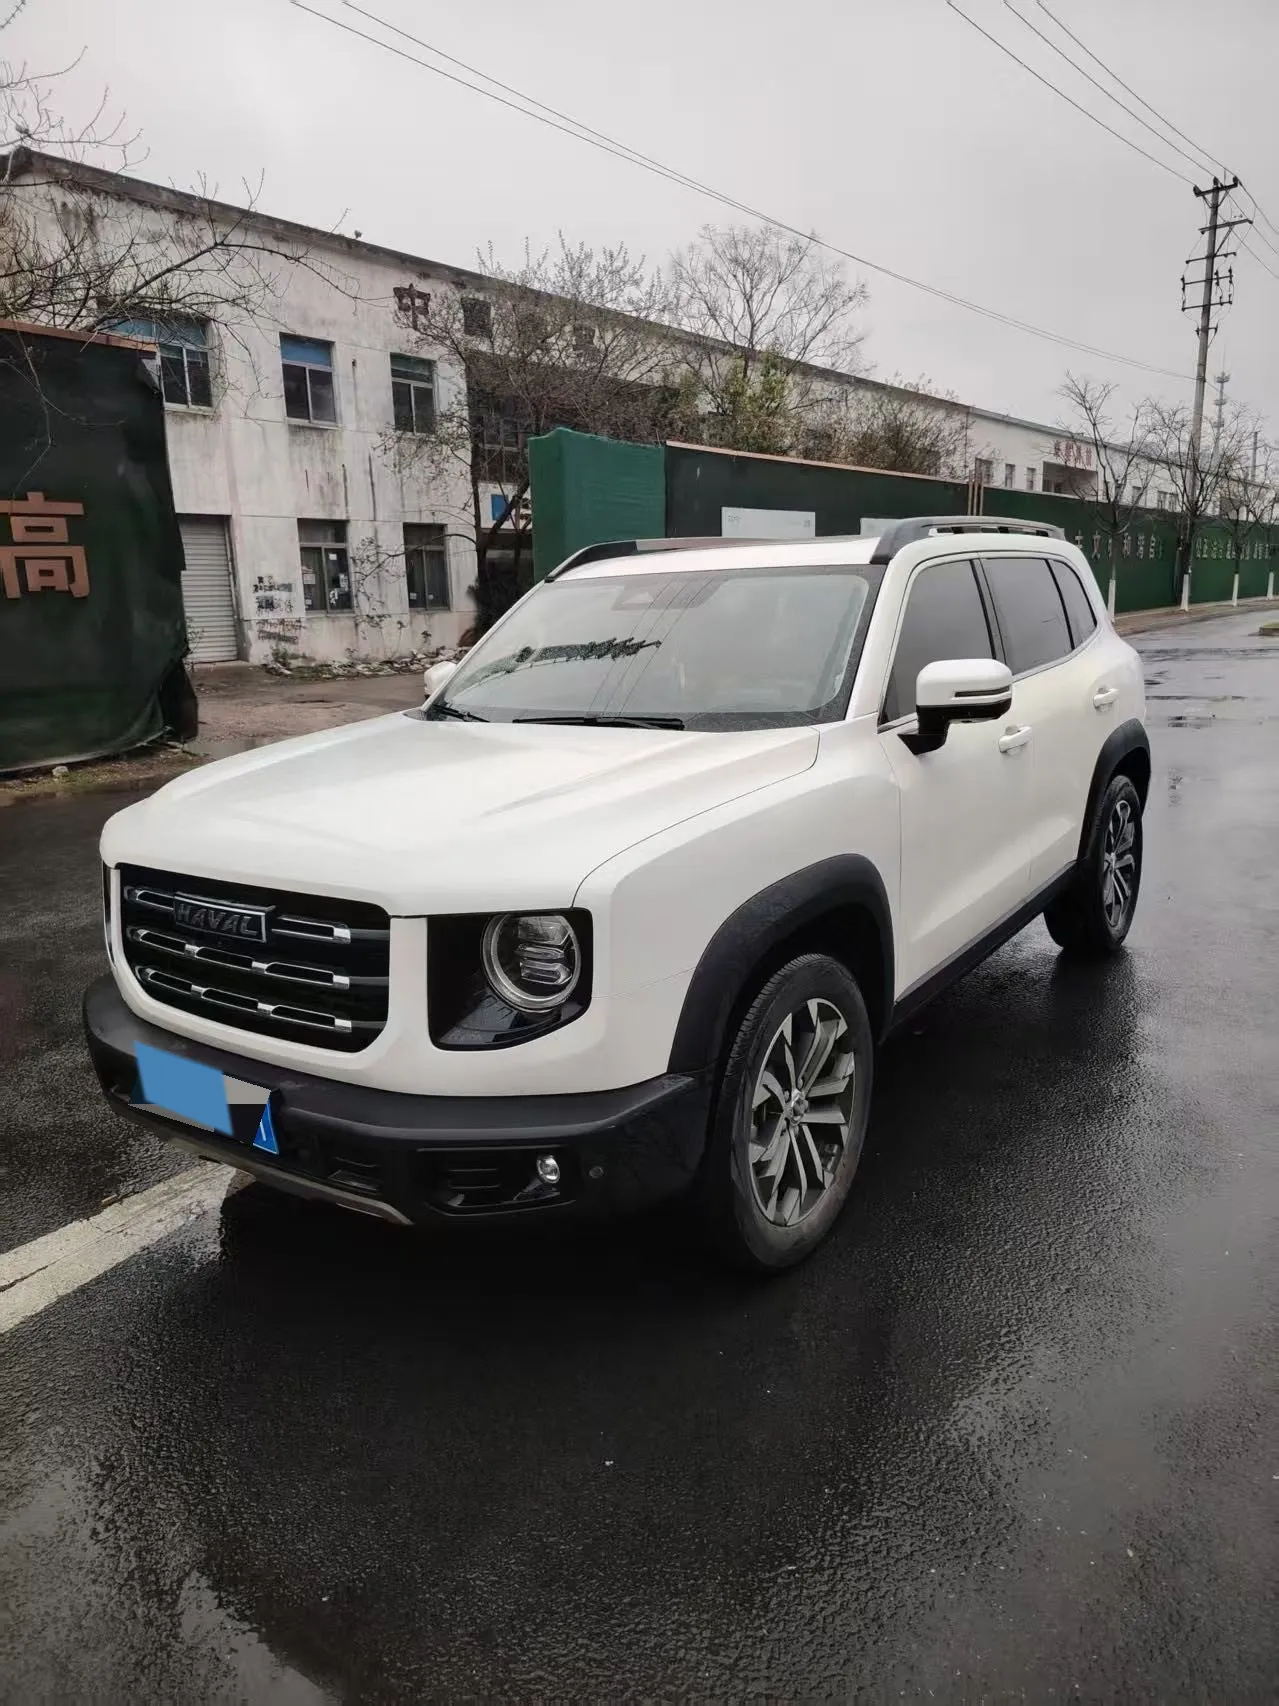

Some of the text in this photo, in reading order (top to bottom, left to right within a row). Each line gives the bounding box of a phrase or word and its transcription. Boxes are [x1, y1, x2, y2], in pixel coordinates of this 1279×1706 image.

[393, 283, 431, 331] 中
[0, 491, 90, 599] 高
[177, 903, 258, 937] HAVAL
